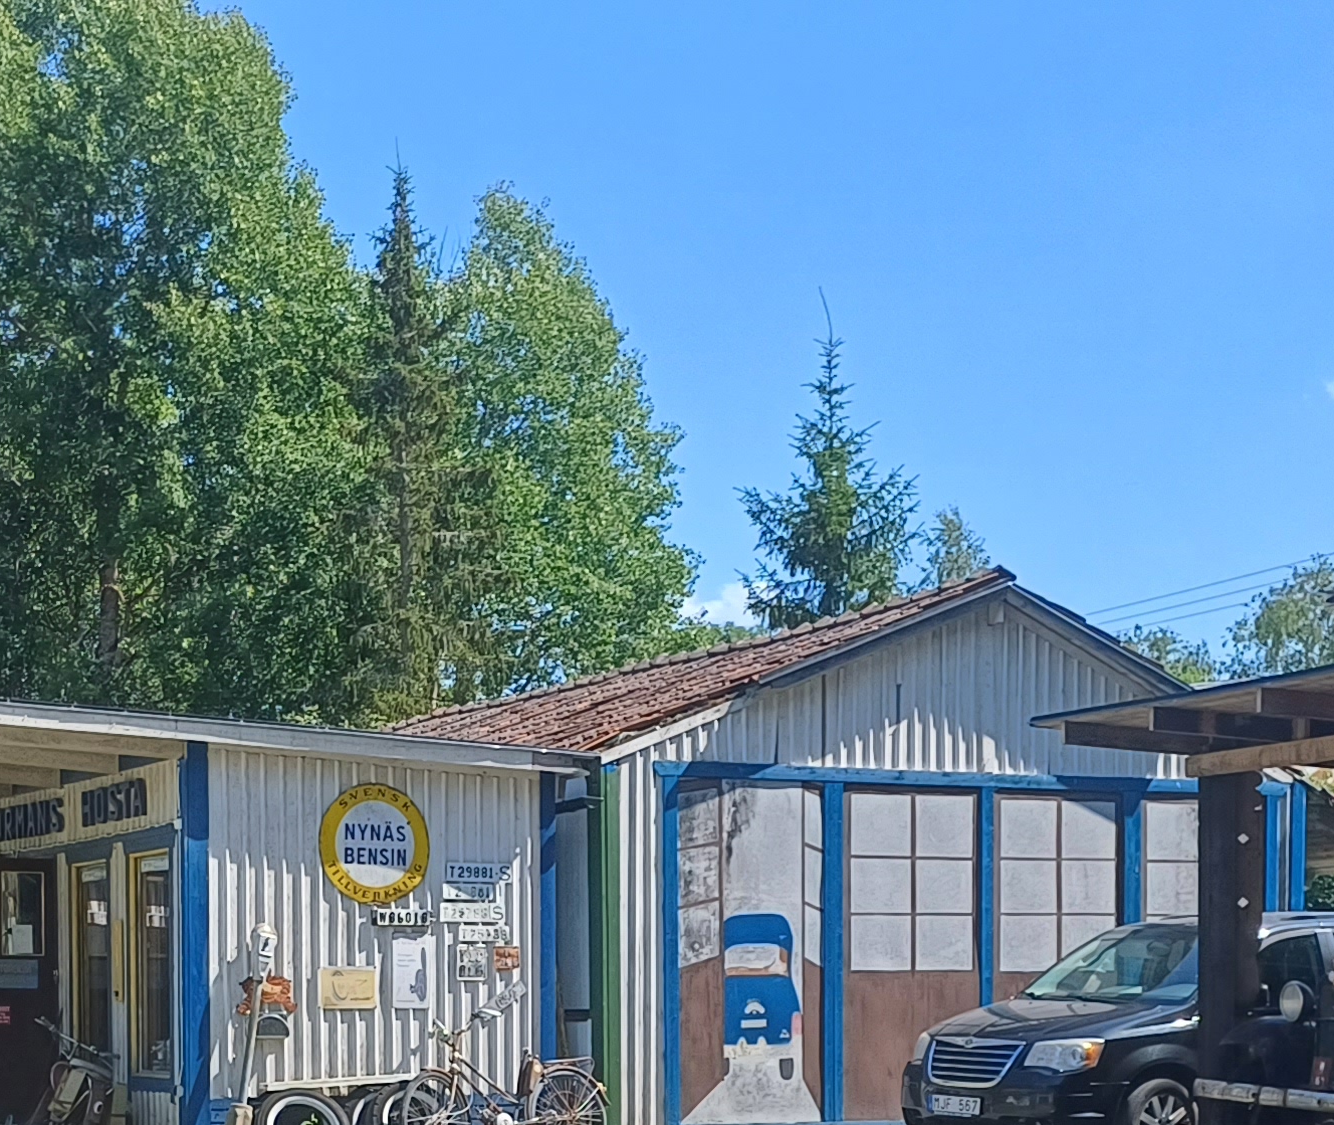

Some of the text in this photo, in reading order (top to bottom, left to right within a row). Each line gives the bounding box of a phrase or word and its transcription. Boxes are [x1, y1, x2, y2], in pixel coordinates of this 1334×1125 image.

[81, 778, 147, 827] HOSTA
[339, 787, 411, 812] SVENSK
[345, 821, 406, 842] NYNÄS
[344, 847, 406, 866] BENSIN
[328, 860, 422, 900] TILLVERKNING
[958, 1098, 978, 1113] 567
